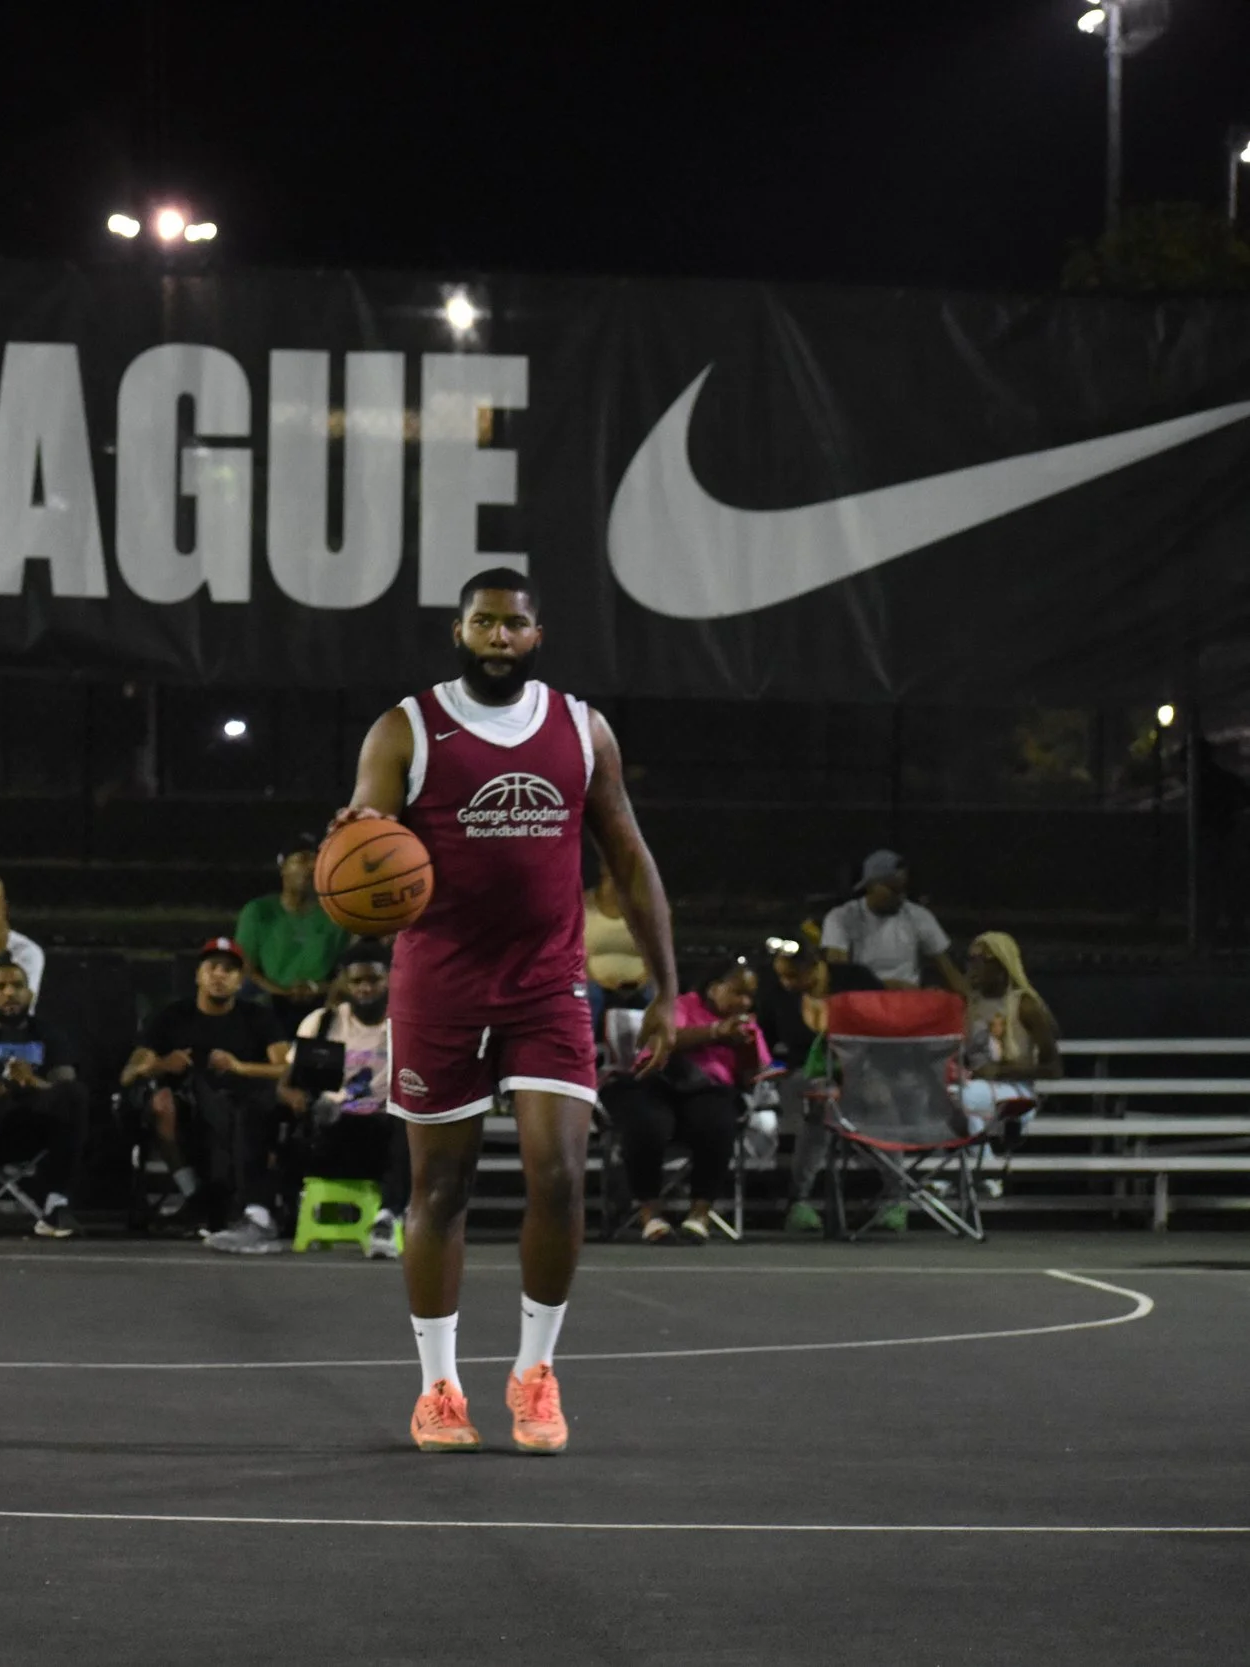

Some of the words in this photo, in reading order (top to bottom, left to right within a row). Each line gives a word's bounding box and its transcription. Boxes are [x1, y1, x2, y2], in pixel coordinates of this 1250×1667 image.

[457, 808, 508, 825] George
[466, 825, 528, 838] Roundball
[530, 825, 563, 837] Classic
